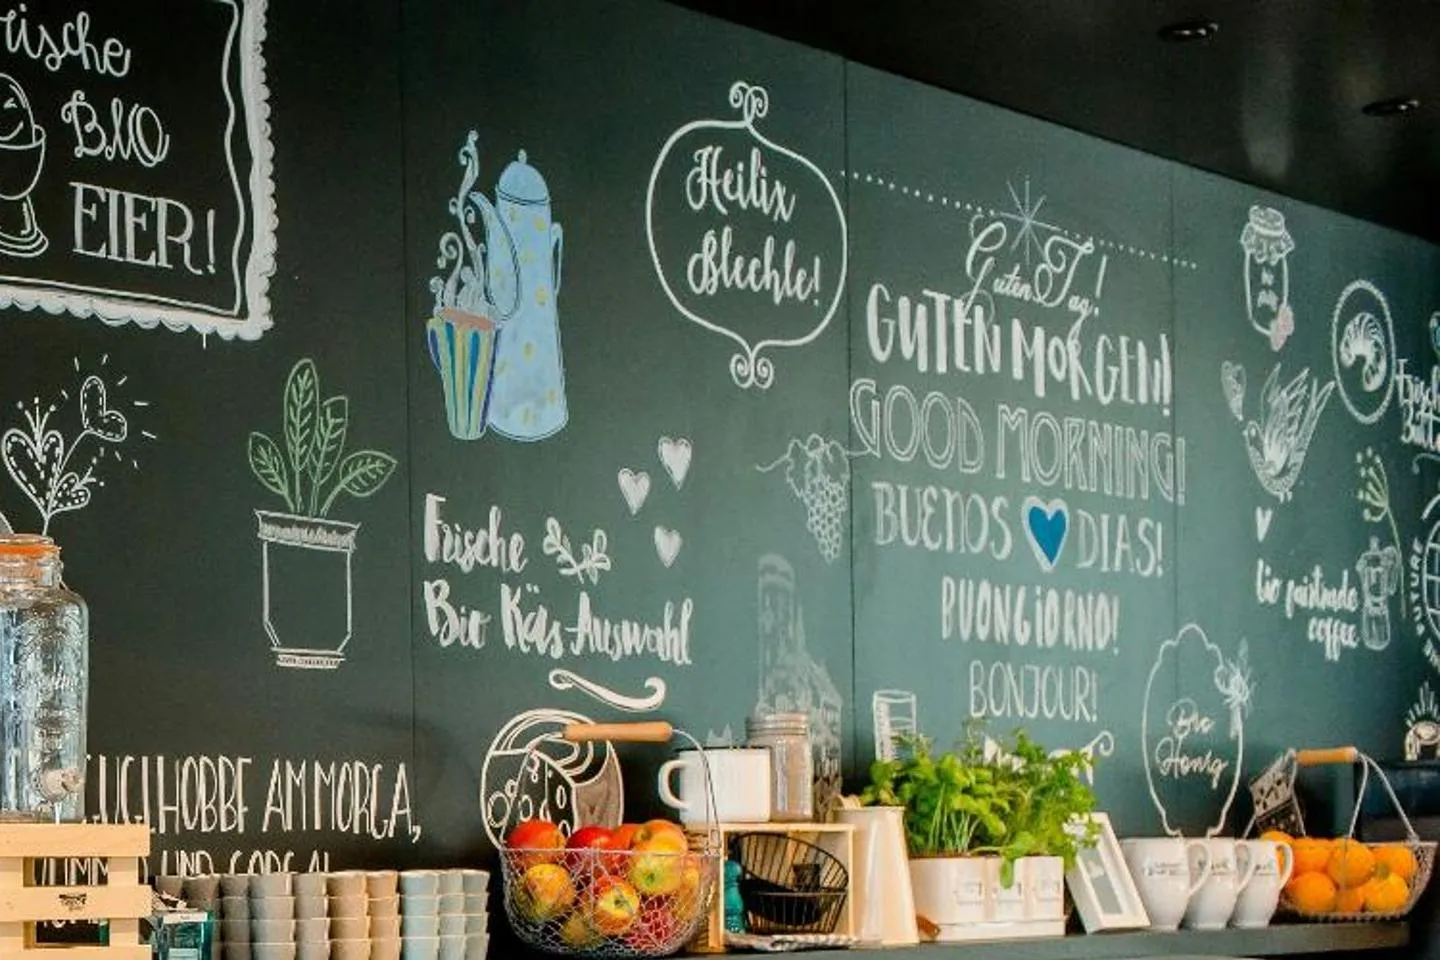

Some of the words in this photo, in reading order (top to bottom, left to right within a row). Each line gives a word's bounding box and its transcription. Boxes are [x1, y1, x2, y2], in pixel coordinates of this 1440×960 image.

[61, 90, 170, 167] BIO
[686, 145, 796, 222] Heilix
[69, 181, 216, 275] EIER!
[687, 226, 820, 306] Blechle!
[954, 214, 1038, 326] Guten
[866, 284, 1001, 374] GUTEN
[849, 378, 984, 473] GOOD
[996, 403, 1187, 506] MORNING!
[424, 492, 528, 574] Frische
[872, 481, 1013, 561] BUENOS
[1076, 509, 1164, 578] DIAS!
[423, 578, 491, 650] Bio
[970, 660, 1097, 723] BONJOUR!
[1166, 698, 1216, 739] Bio
[262, 757, 311, 833] AM
[1155, 736, 1229, 790] Honig
